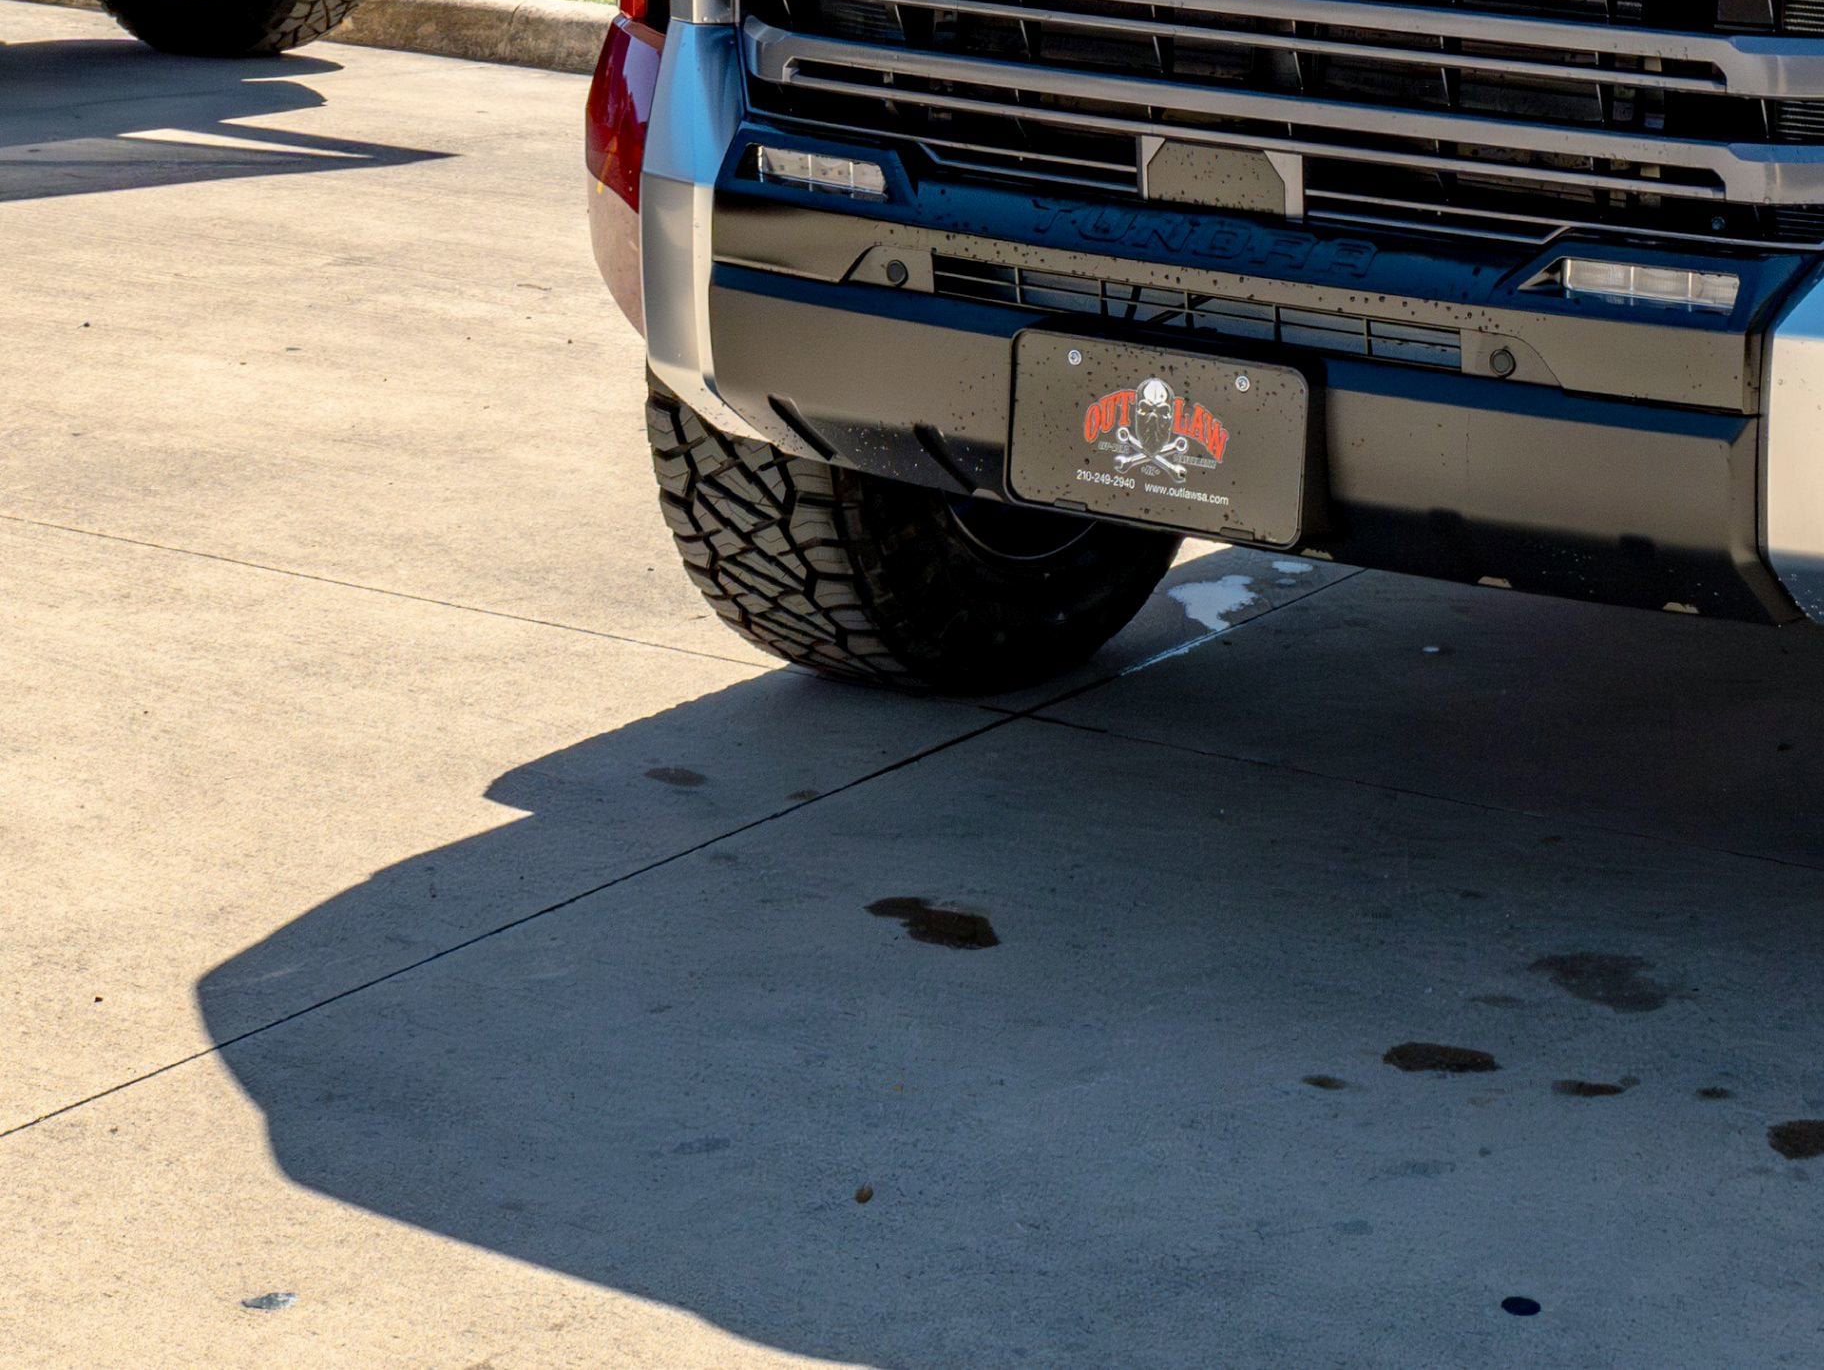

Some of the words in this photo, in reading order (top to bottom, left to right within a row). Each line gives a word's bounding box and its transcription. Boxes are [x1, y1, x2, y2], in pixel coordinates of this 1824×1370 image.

[1032, 198, 1378, 278] TUNDRA
[1077, 469, 1136, 490] 210-249-2940
[1145, 483, 1230, 506] www.outlawsa.com
